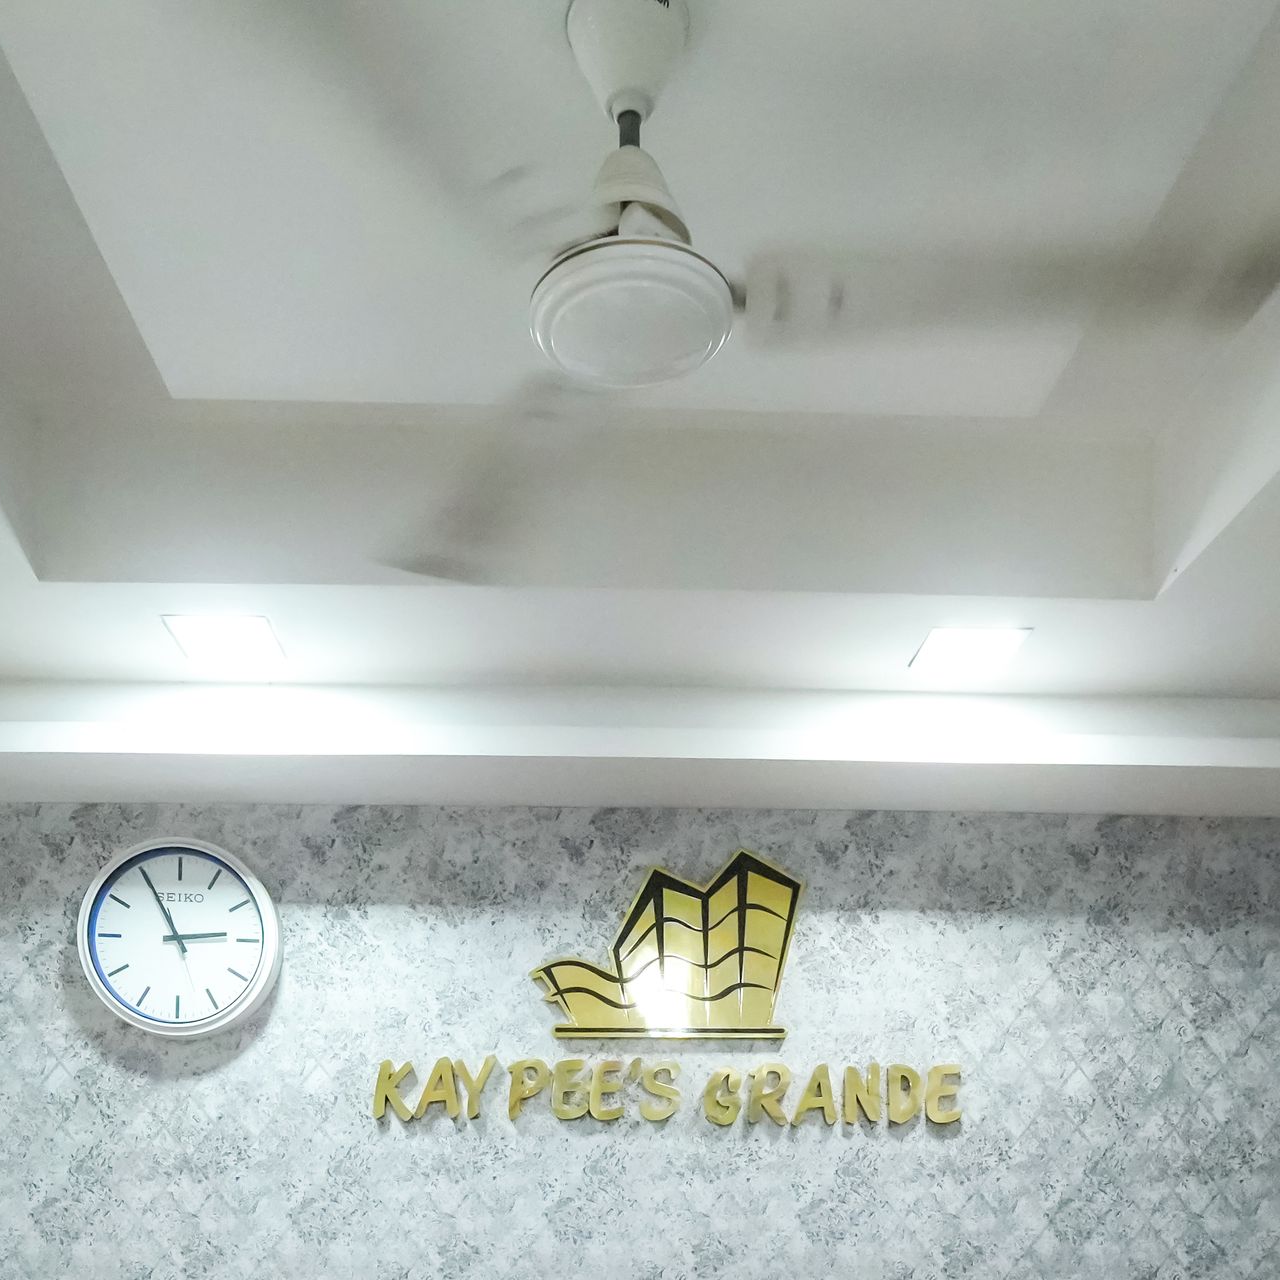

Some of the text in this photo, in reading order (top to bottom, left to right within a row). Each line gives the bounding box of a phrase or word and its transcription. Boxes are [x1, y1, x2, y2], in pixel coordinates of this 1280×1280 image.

[157, 892, 205, 903] SEIKO
[372, 1055, 963, 1126] KAY PEE'S GRANDE
